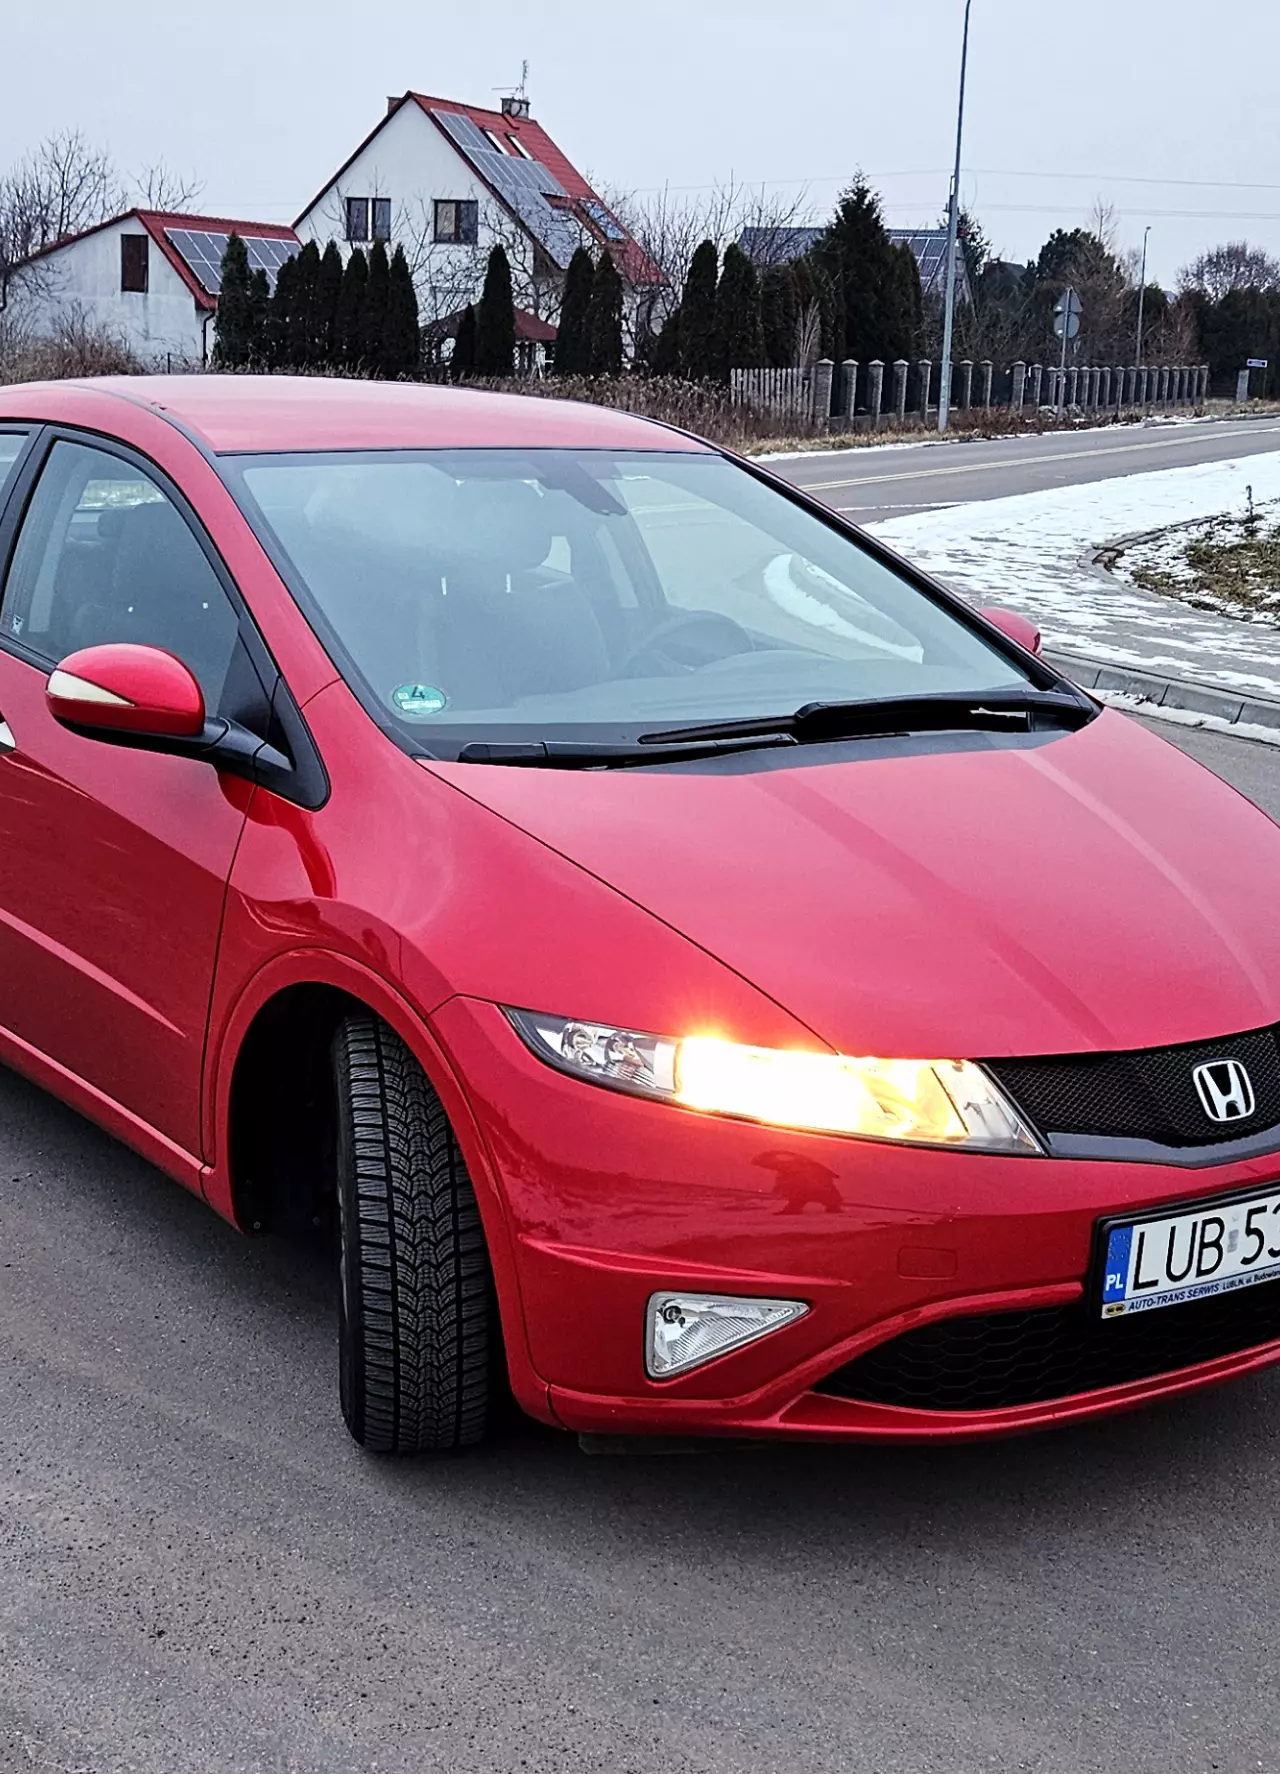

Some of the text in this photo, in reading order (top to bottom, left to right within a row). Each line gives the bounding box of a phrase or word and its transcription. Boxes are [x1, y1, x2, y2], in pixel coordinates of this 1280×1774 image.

[411, 685, 425, 699] 4
[1132, 1216, 1225, 1291] LUB
[1105, 1273, 1124, 1291] PL
[1128, 1290, 1186, 1312] AUTO-TRANS
[1186, 1283, 1220, 1299] SERWIS
